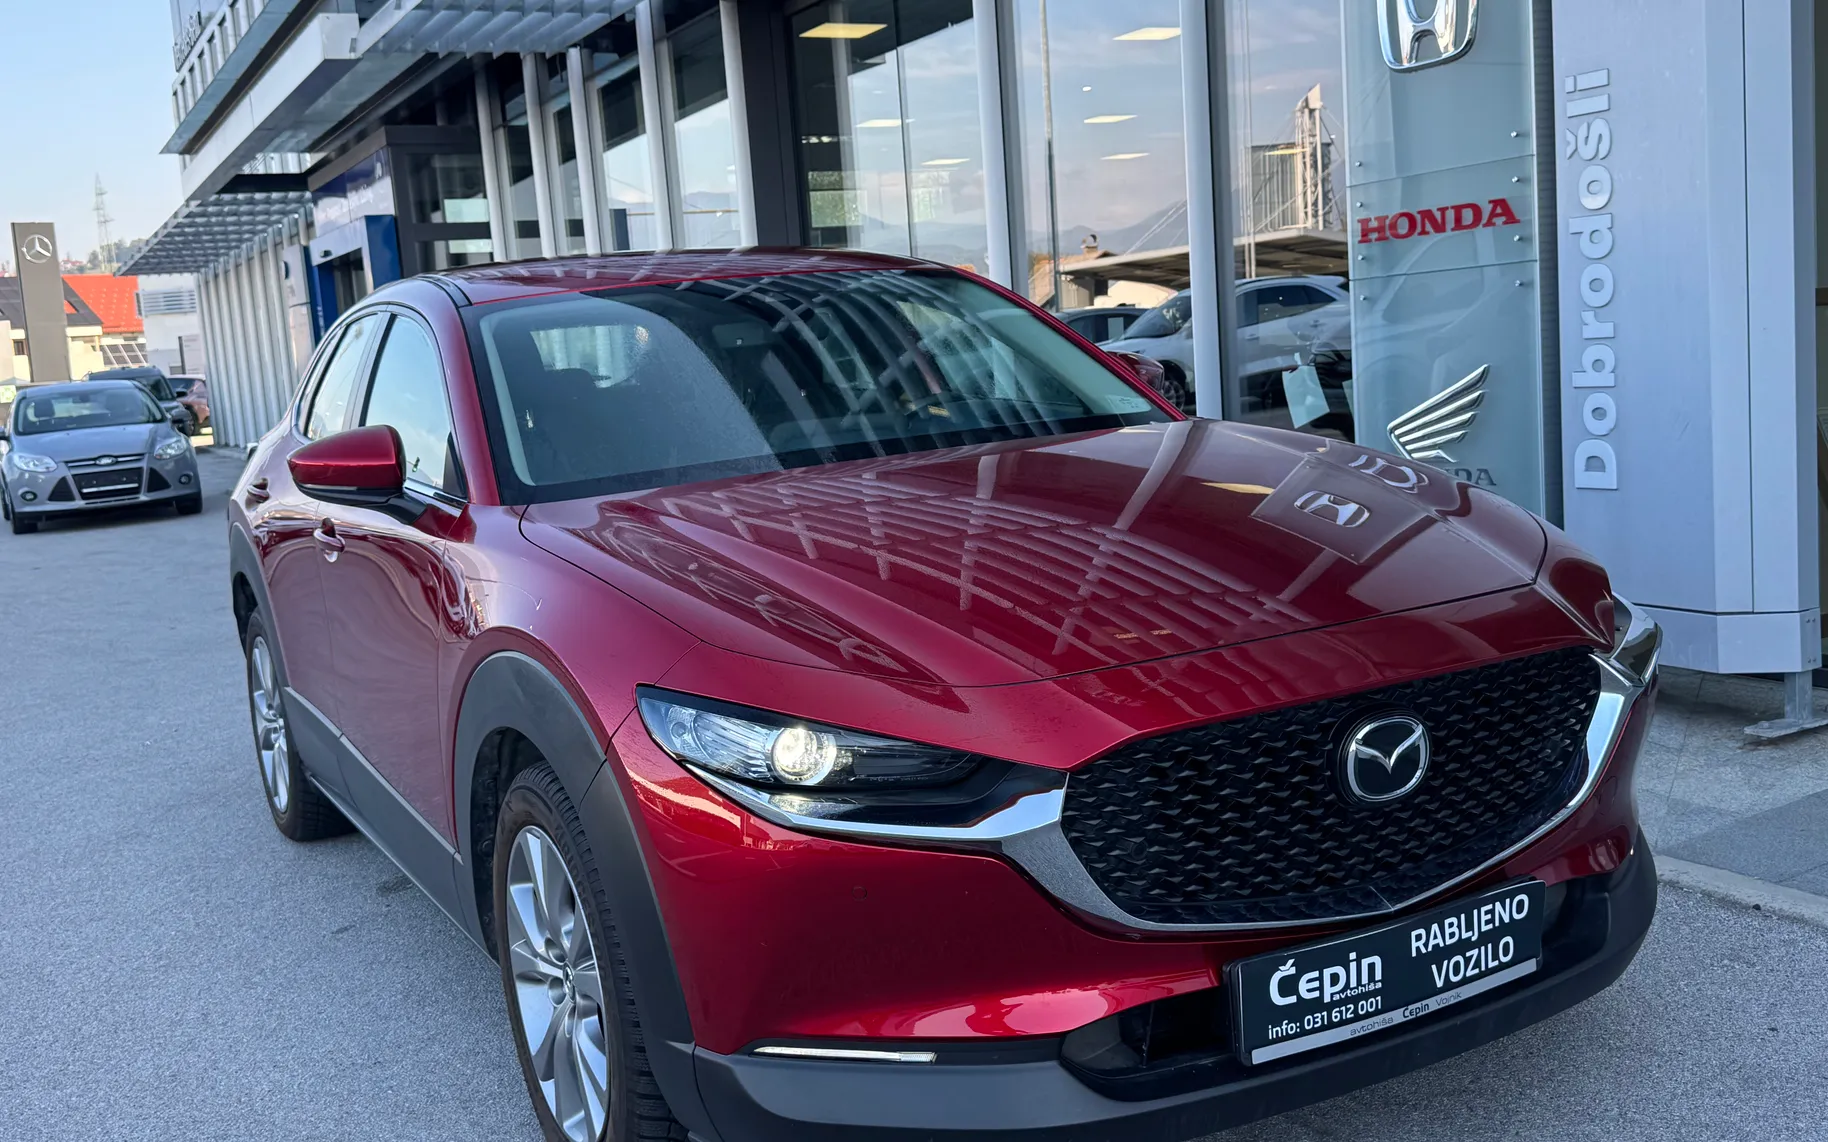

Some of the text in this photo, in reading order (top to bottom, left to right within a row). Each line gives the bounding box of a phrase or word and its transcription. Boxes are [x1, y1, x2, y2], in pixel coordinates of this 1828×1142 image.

[1357, 198, 1520, 244] HONDA
[1565, 68, 1619, 491] Dobrodošli
[1410, 893, 1530, 957] RABLJENO
[1269, 951, 1382, 1006] Čepin
[1431, 935, 1514, 988] VOZILO
[1332, 981, 1382, 1001] avtohiša
[1268, 996, 1382, 1039] info: 031 612 001
[1350, 1016, 1394, 1036] avtohiša
[1402, 1002, 1430, 1018] Čepin
